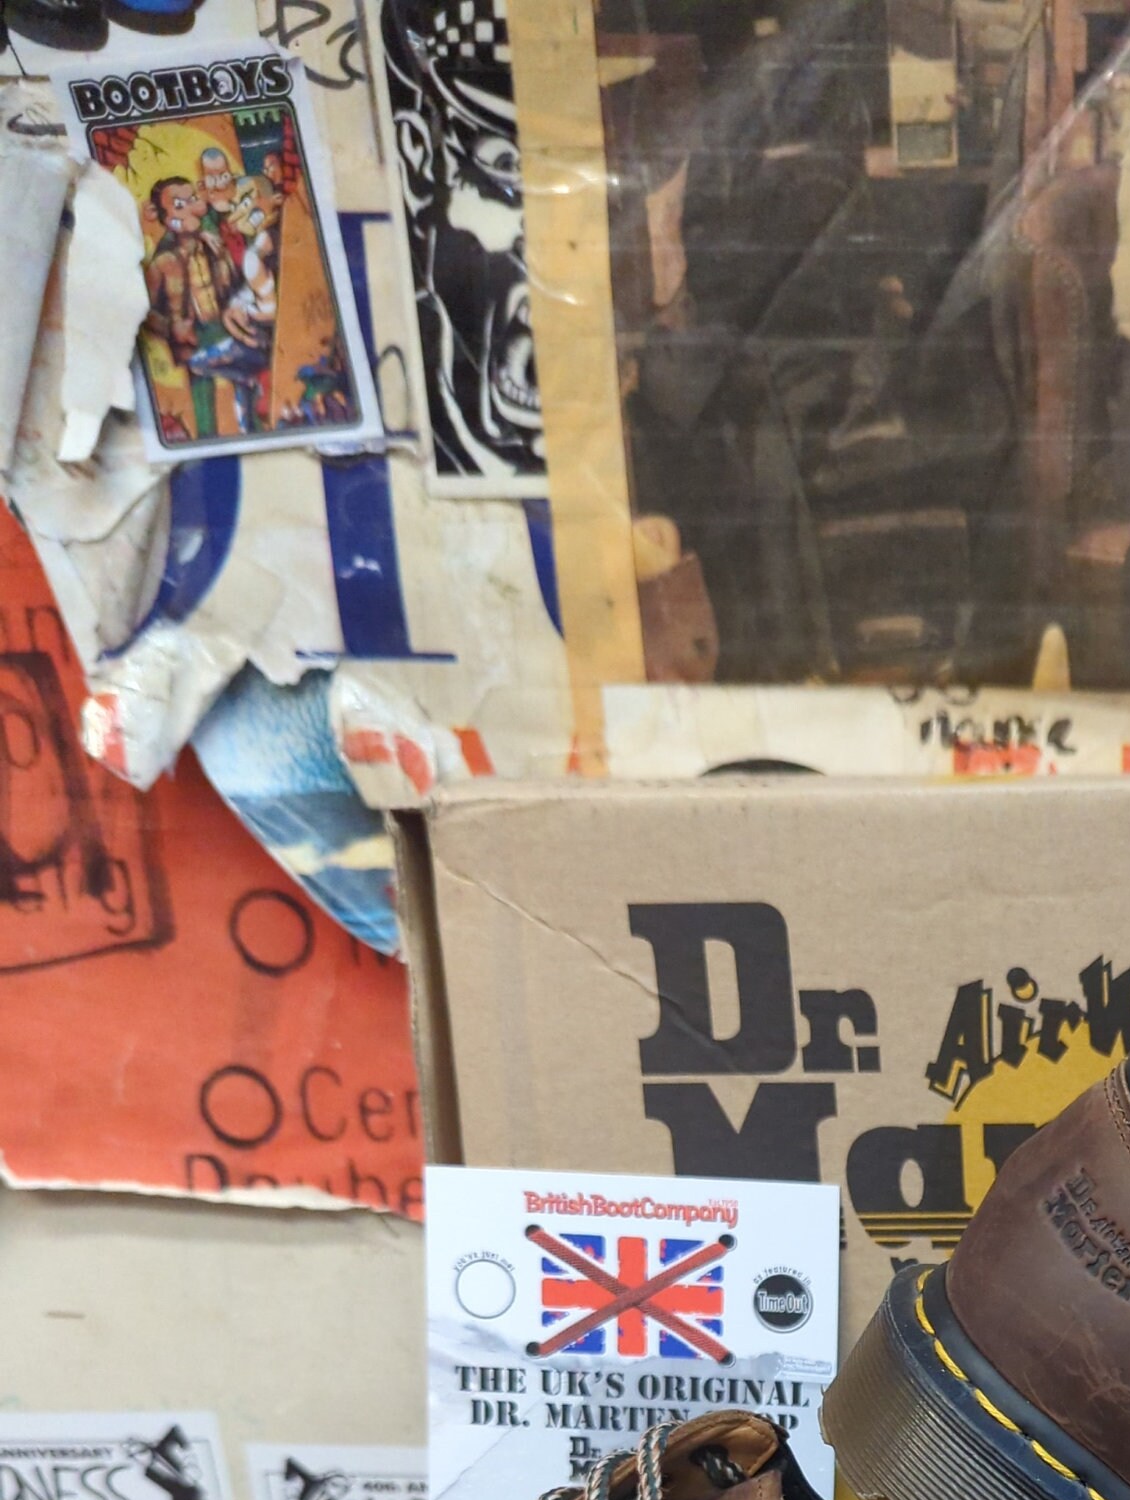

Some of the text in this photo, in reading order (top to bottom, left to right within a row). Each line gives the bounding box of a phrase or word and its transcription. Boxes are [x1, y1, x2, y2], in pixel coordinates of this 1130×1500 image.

[69, 55, 294, 122] BOOTBOYS
[456, 1365, 810, 1408] THE UK'S ORIGINAL
[470, 1398, 531, 1428] DR.
